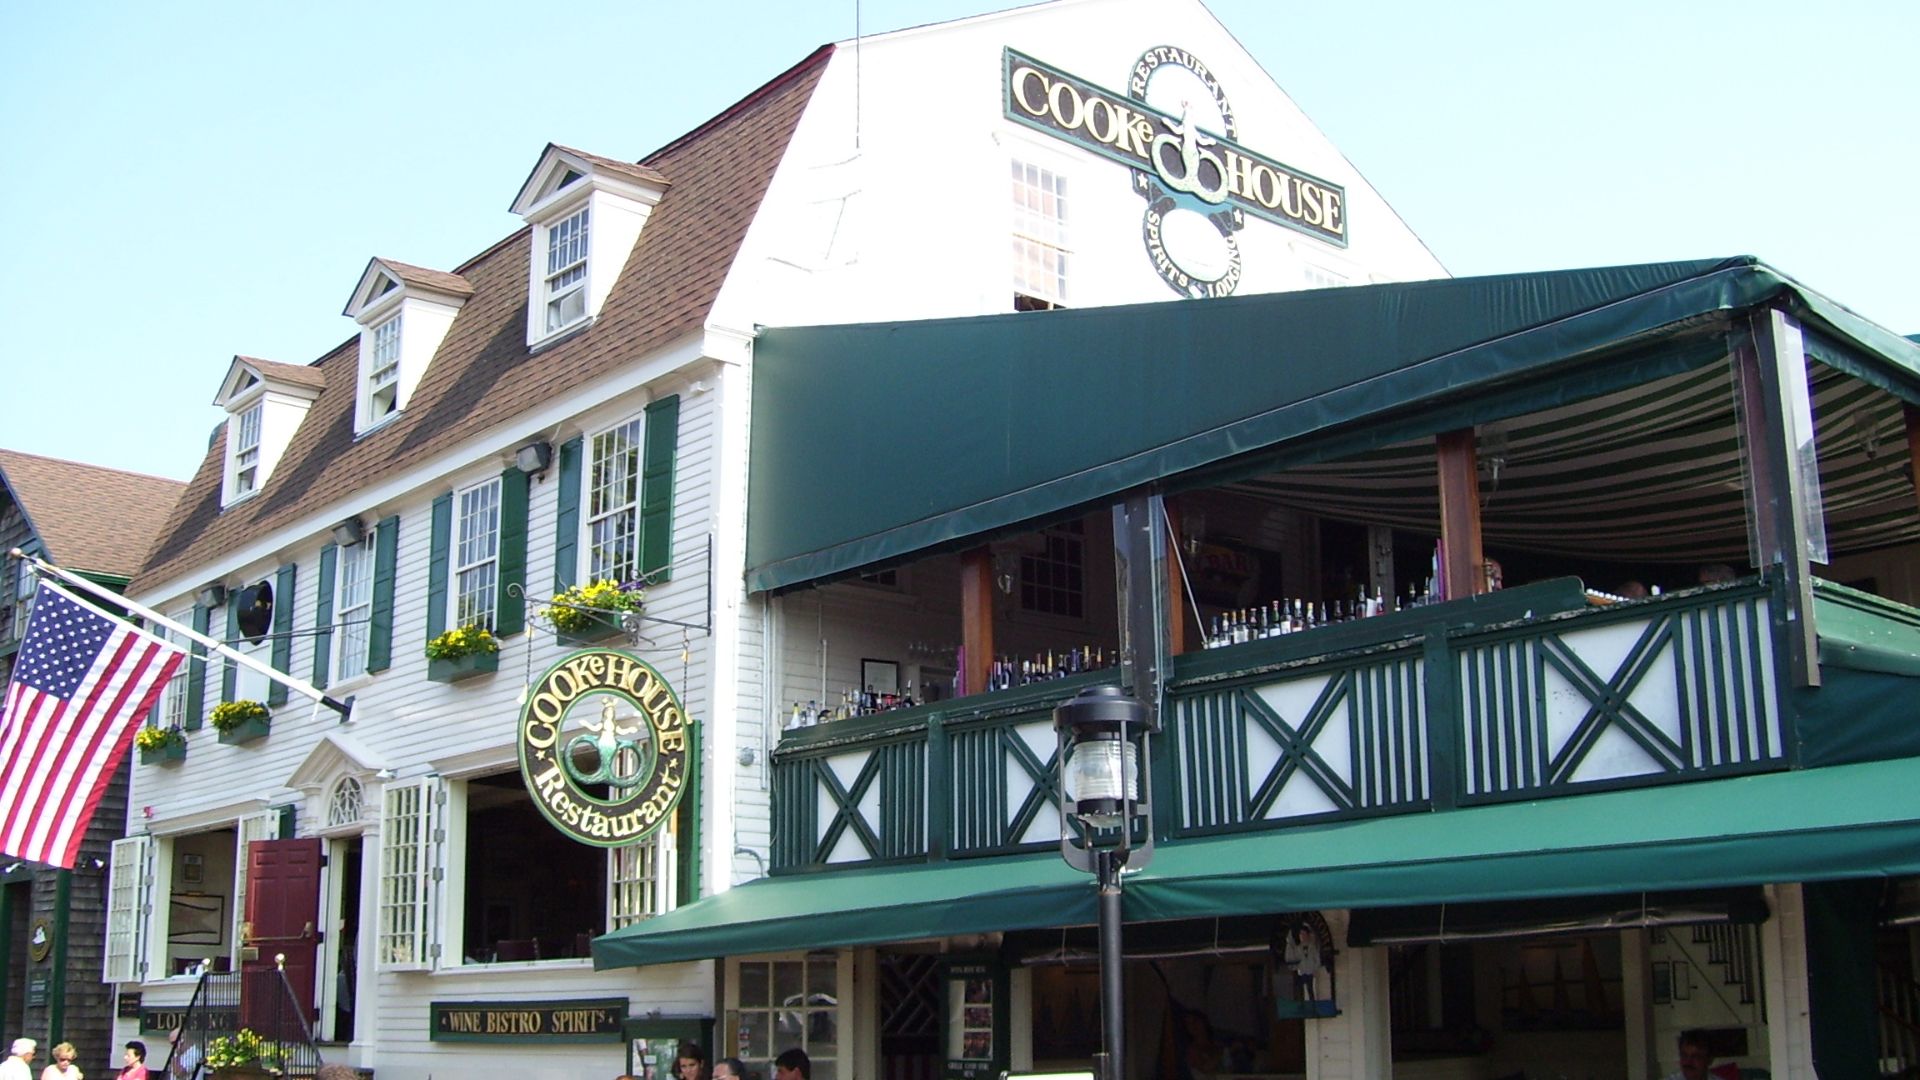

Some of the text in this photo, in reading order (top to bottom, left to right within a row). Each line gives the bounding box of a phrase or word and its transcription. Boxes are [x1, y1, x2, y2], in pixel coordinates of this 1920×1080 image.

[1131, 47, 1237, 137] RESTAURANT
[1225, 150, 1343, 234] HOUSE
[1147, 210, 1188, 287] SPIRITS
[1207, 236, 1240, 298] LODGING
[604, 655, 685, 755] HOUSE
[534, 757, 680, 837] Restaurant
[448, 1010, 605, 1033] WINE BISTRO SPIRITS
